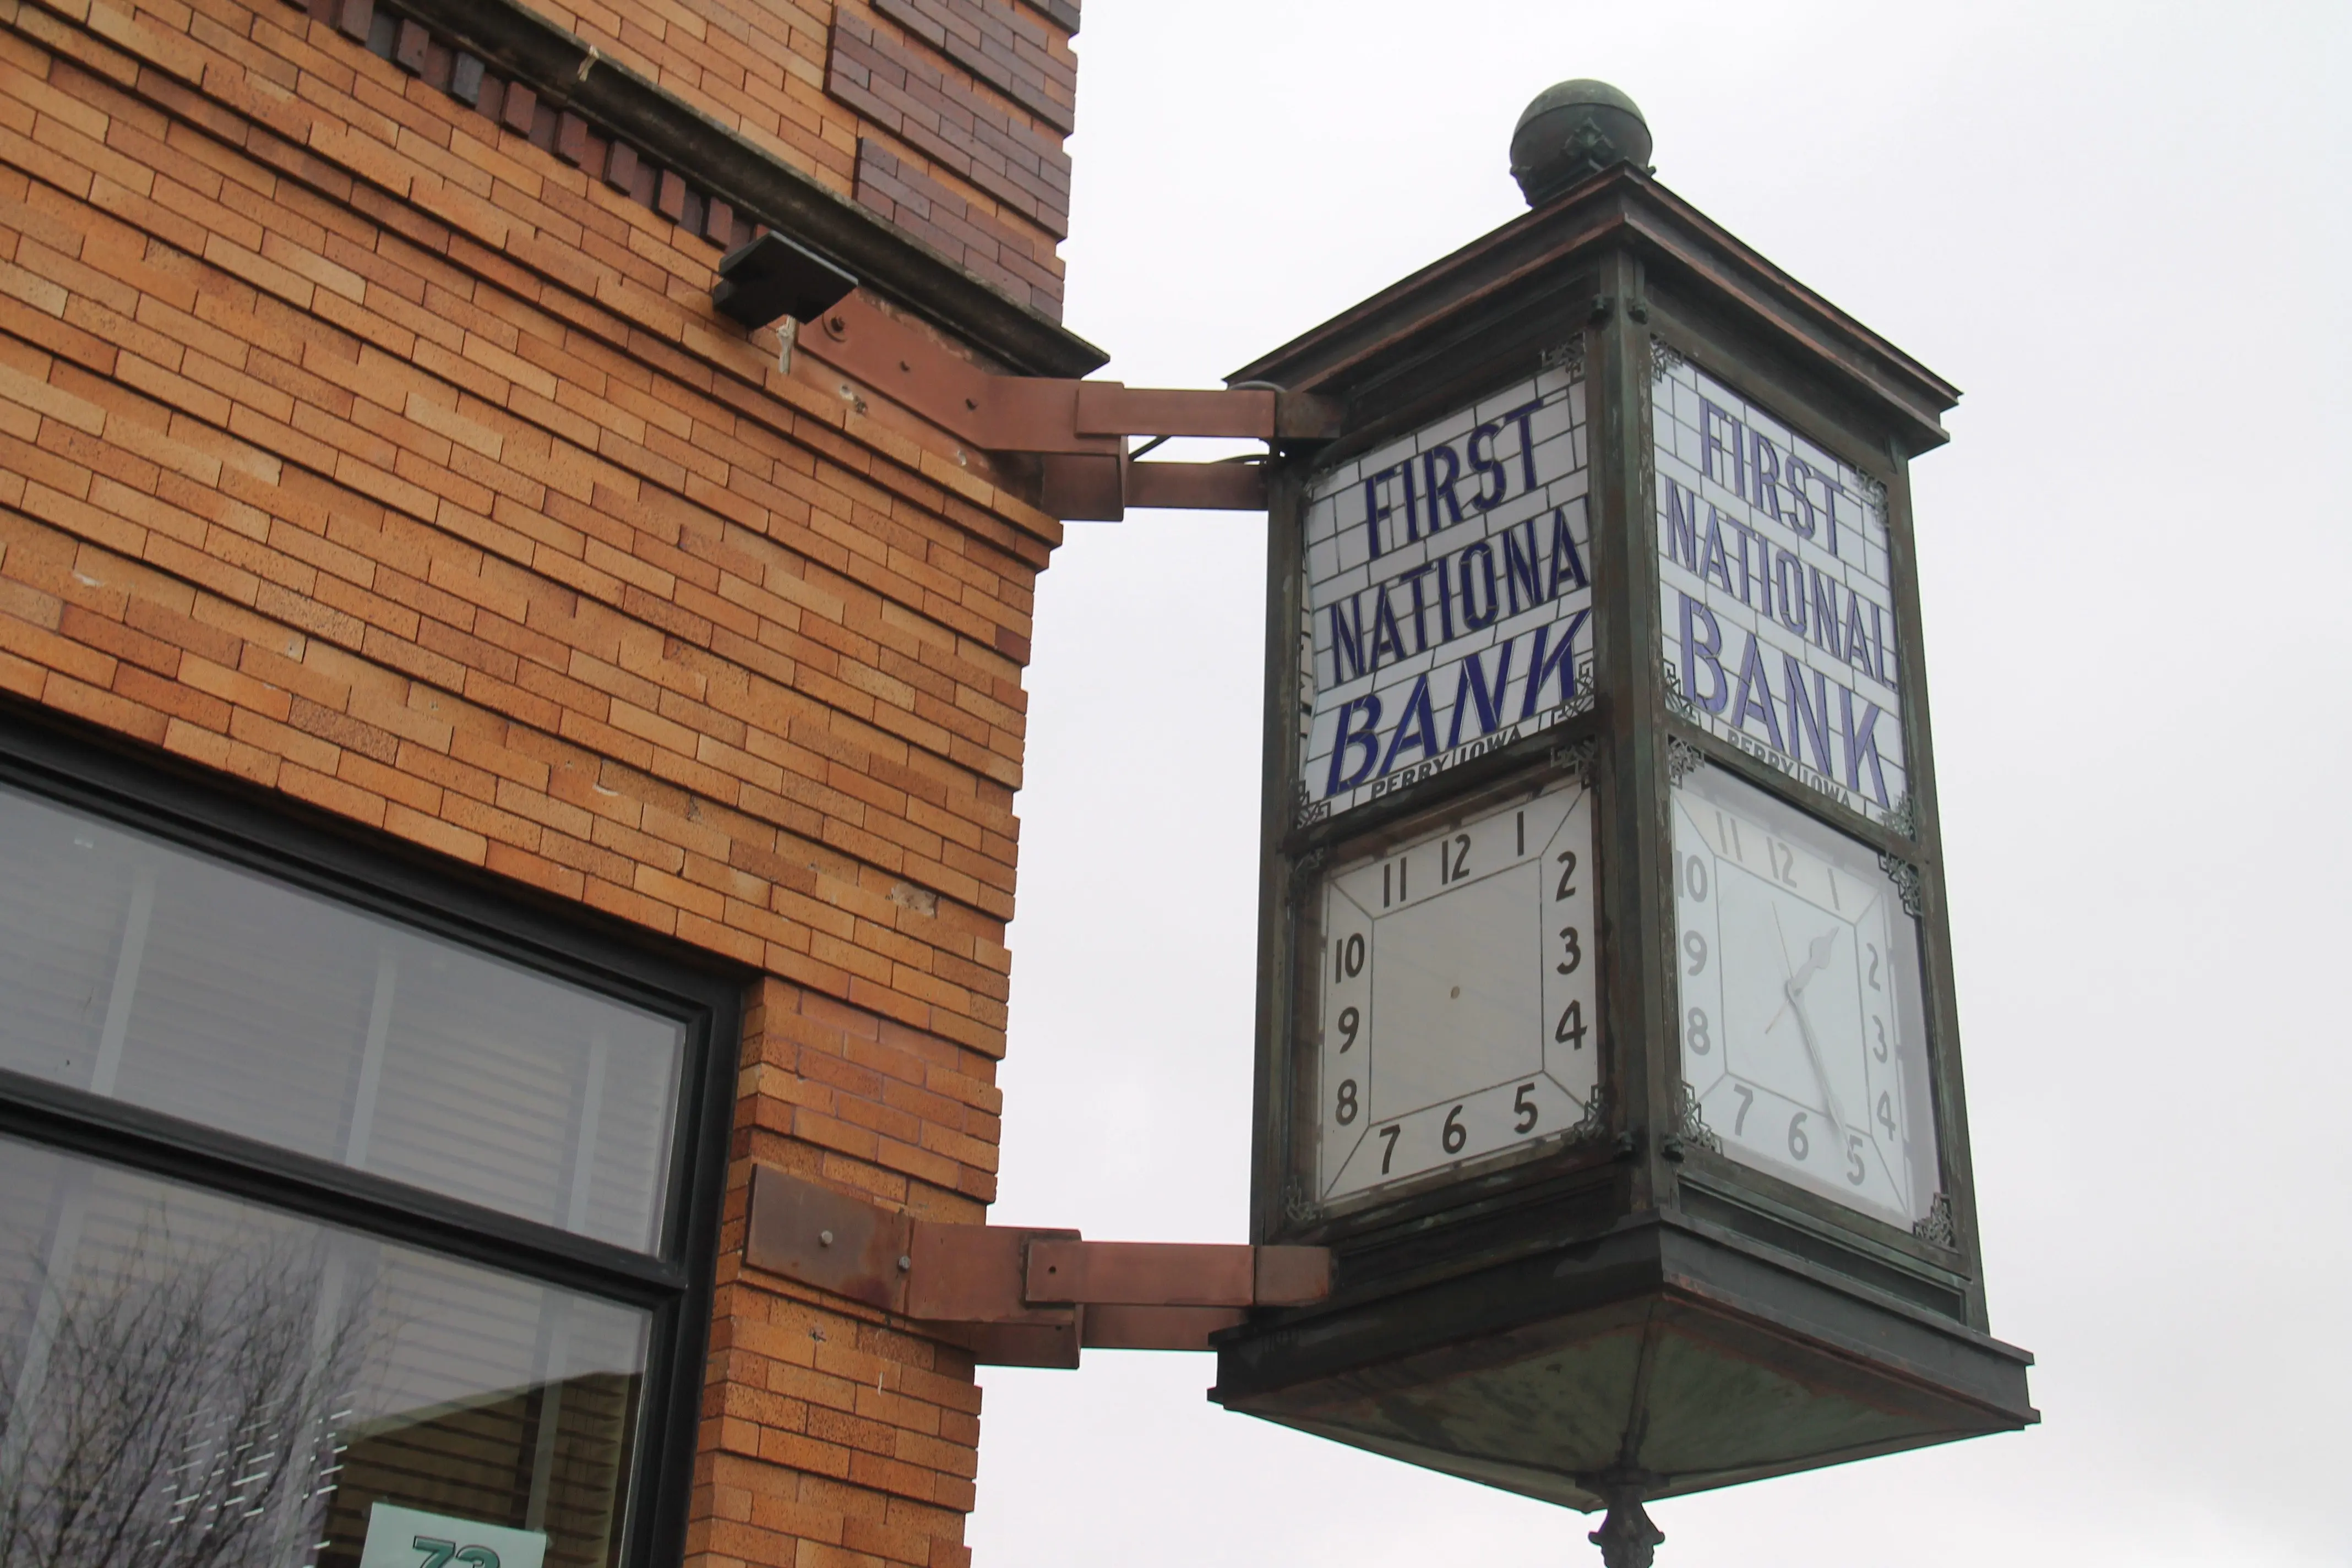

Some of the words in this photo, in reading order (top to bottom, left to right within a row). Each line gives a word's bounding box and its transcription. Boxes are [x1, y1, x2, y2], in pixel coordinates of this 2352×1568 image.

[1365, 399, 1544, 561] FIRST
[1699, 393, 1844, 557] FIRST
[1330, 495, 1589, 687] NATIONA
[1666, 475, 1897, 692] NATIONAL
[1325, 609, 1591, 798] BANK
[1679, 591, 1891, 809] BANK
[1371, 755, 1449, 799] PERRY
[1459, 724, 1522, 765] IOWA
[1728, 728, 1794, 776] PERRY
[1803, 770, 1851, 809] IOWA
[1441, 833, 1472, 885] 12
[1517, 811, 1525, 856] 1
[1716, 811, 1743, 863] 11
[1383, 857, 1407, 908] 11
[1556, 851, 1577, 902] 2
[1676, 850, 1708, 902] 10
[1766, 836, 1797, 889] 12
[1827, 868, 1840, 911] 1
[1335, 933, 1365, 983] 10
[1557, 927, 1581, 975] 3
[1683, 930, 1708, 976] 9
[1867, 943, 1881, 991] 2
[1337, 1006, 1360, 1054] 9
[1555, 1000, 1587, 1050] 4
[1686, 1007, 1711, 1055] 8
[1872, 1015, 1888, 1063] 3
[1335, 1079, 1358, 1125] 8
[1513, 1082, 1539, 1134] 5
[1733, 1083, 1754, 1136] 7
[1877, 1090, 1896, 1141] 4
[1379, 1124, 1401, 1175] 7
[1442, 1104, 1467, 1154] 6
[1788, 1112, 1809, 1161] 6
[1846, 1137, 1866, 1186] 5
